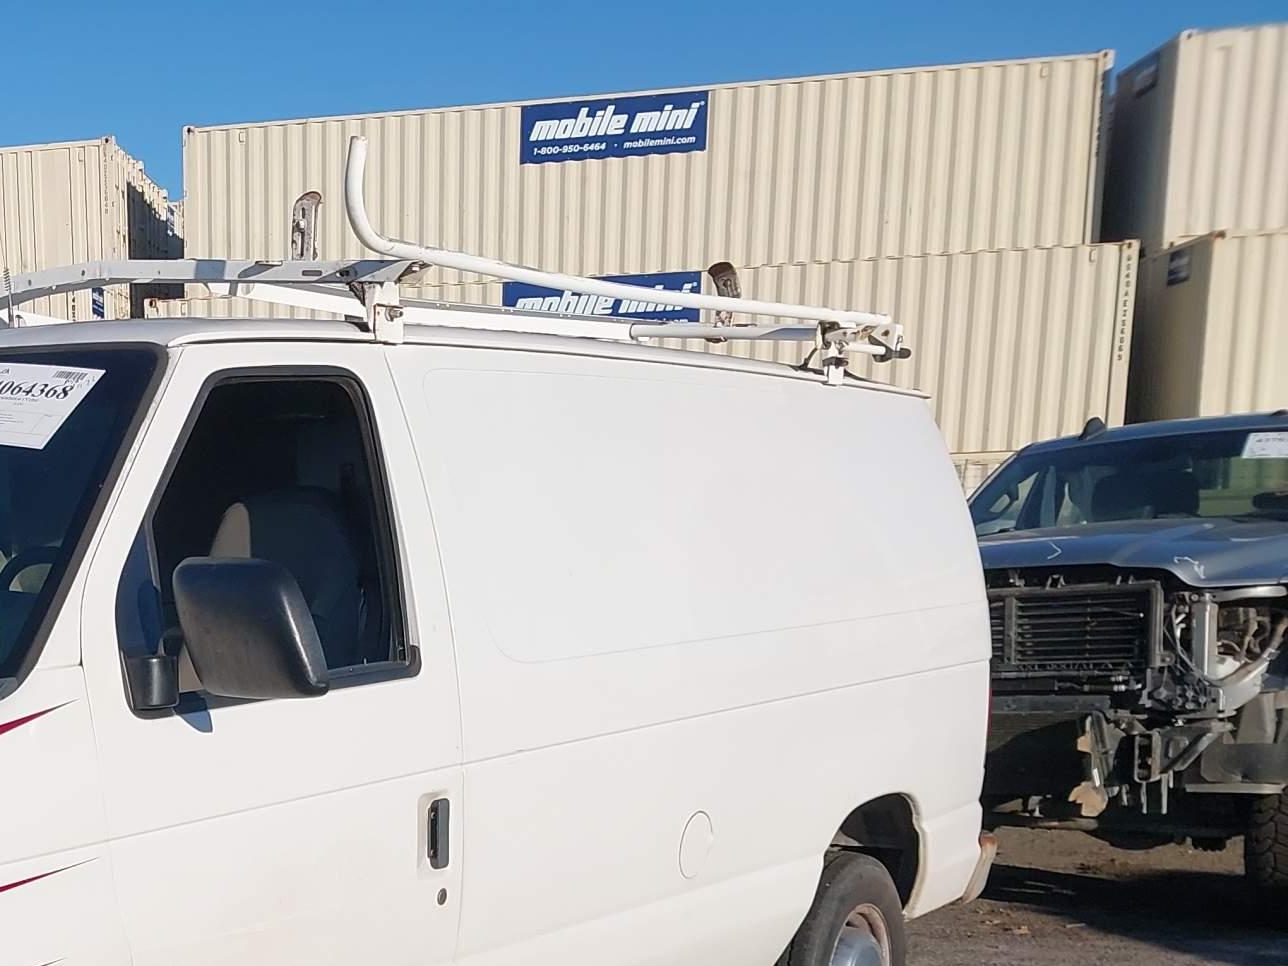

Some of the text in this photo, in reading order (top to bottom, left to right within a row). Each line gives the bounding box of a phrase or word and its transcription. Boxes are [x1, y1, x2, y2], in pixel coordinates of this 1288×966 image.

[529, 102, 700, 142] mobile mini
[533, 136, 696, 156] 1-800-950-6464 mobilemini.com
